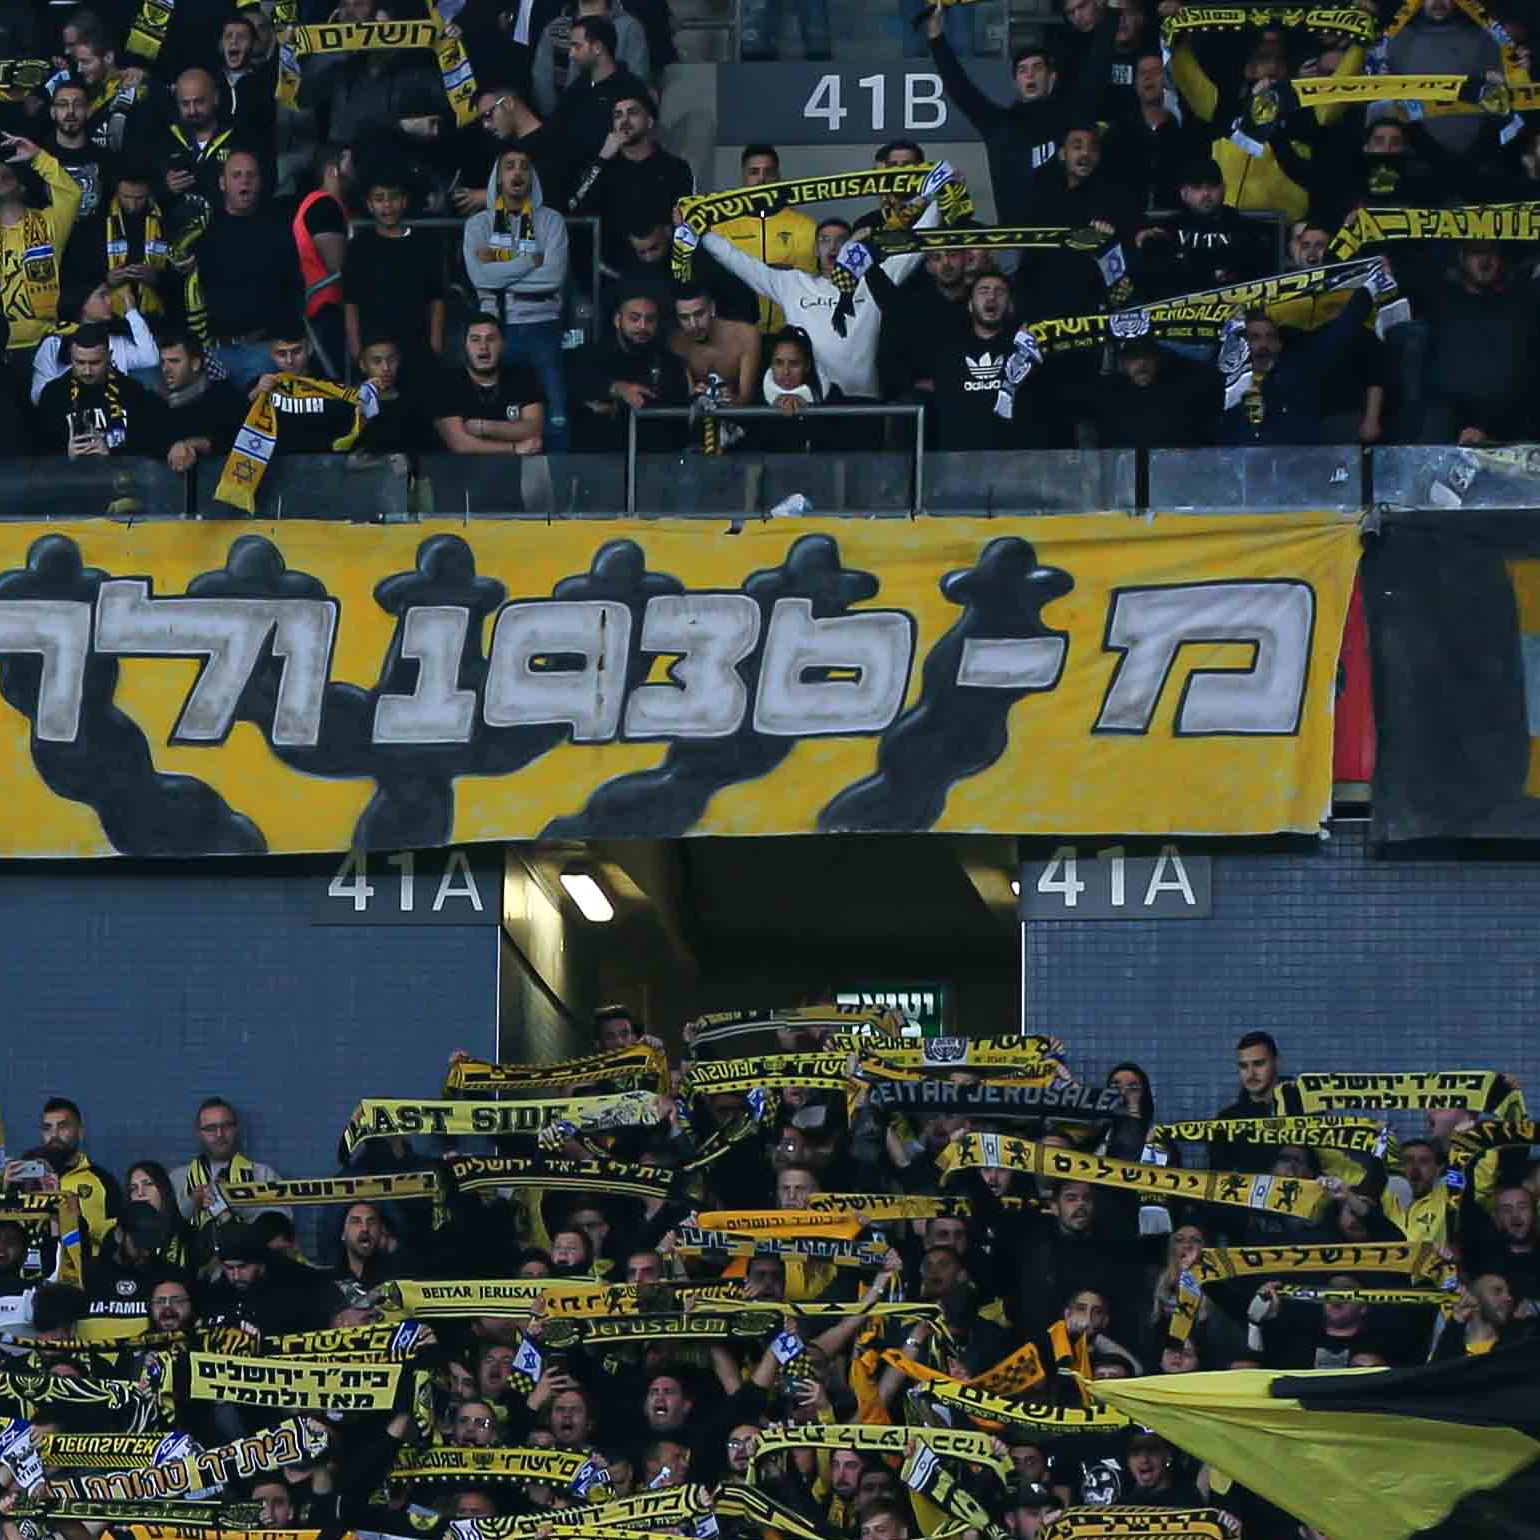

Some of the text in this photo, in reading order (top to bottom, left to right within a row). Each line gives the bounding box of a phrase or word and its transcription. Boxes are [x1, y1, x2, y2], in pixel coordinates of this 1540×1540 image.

[804, 74, 948, 130] 41B
[786, 171, 923, 206] JERUSALEM
[688, 188, 779, 235] ירושלים
[1038, 847, 1198, 911] 41A
[969, 1082, 1123, 1111] JERUSALE
[1054, 1152, 1201, 1189] ירושלים
[1239, 1246, 1410, 1267] ירושלים
[422, 1286, 473, 1299] BEITAR
[198, 1361, 320, 1387] ירושלים
